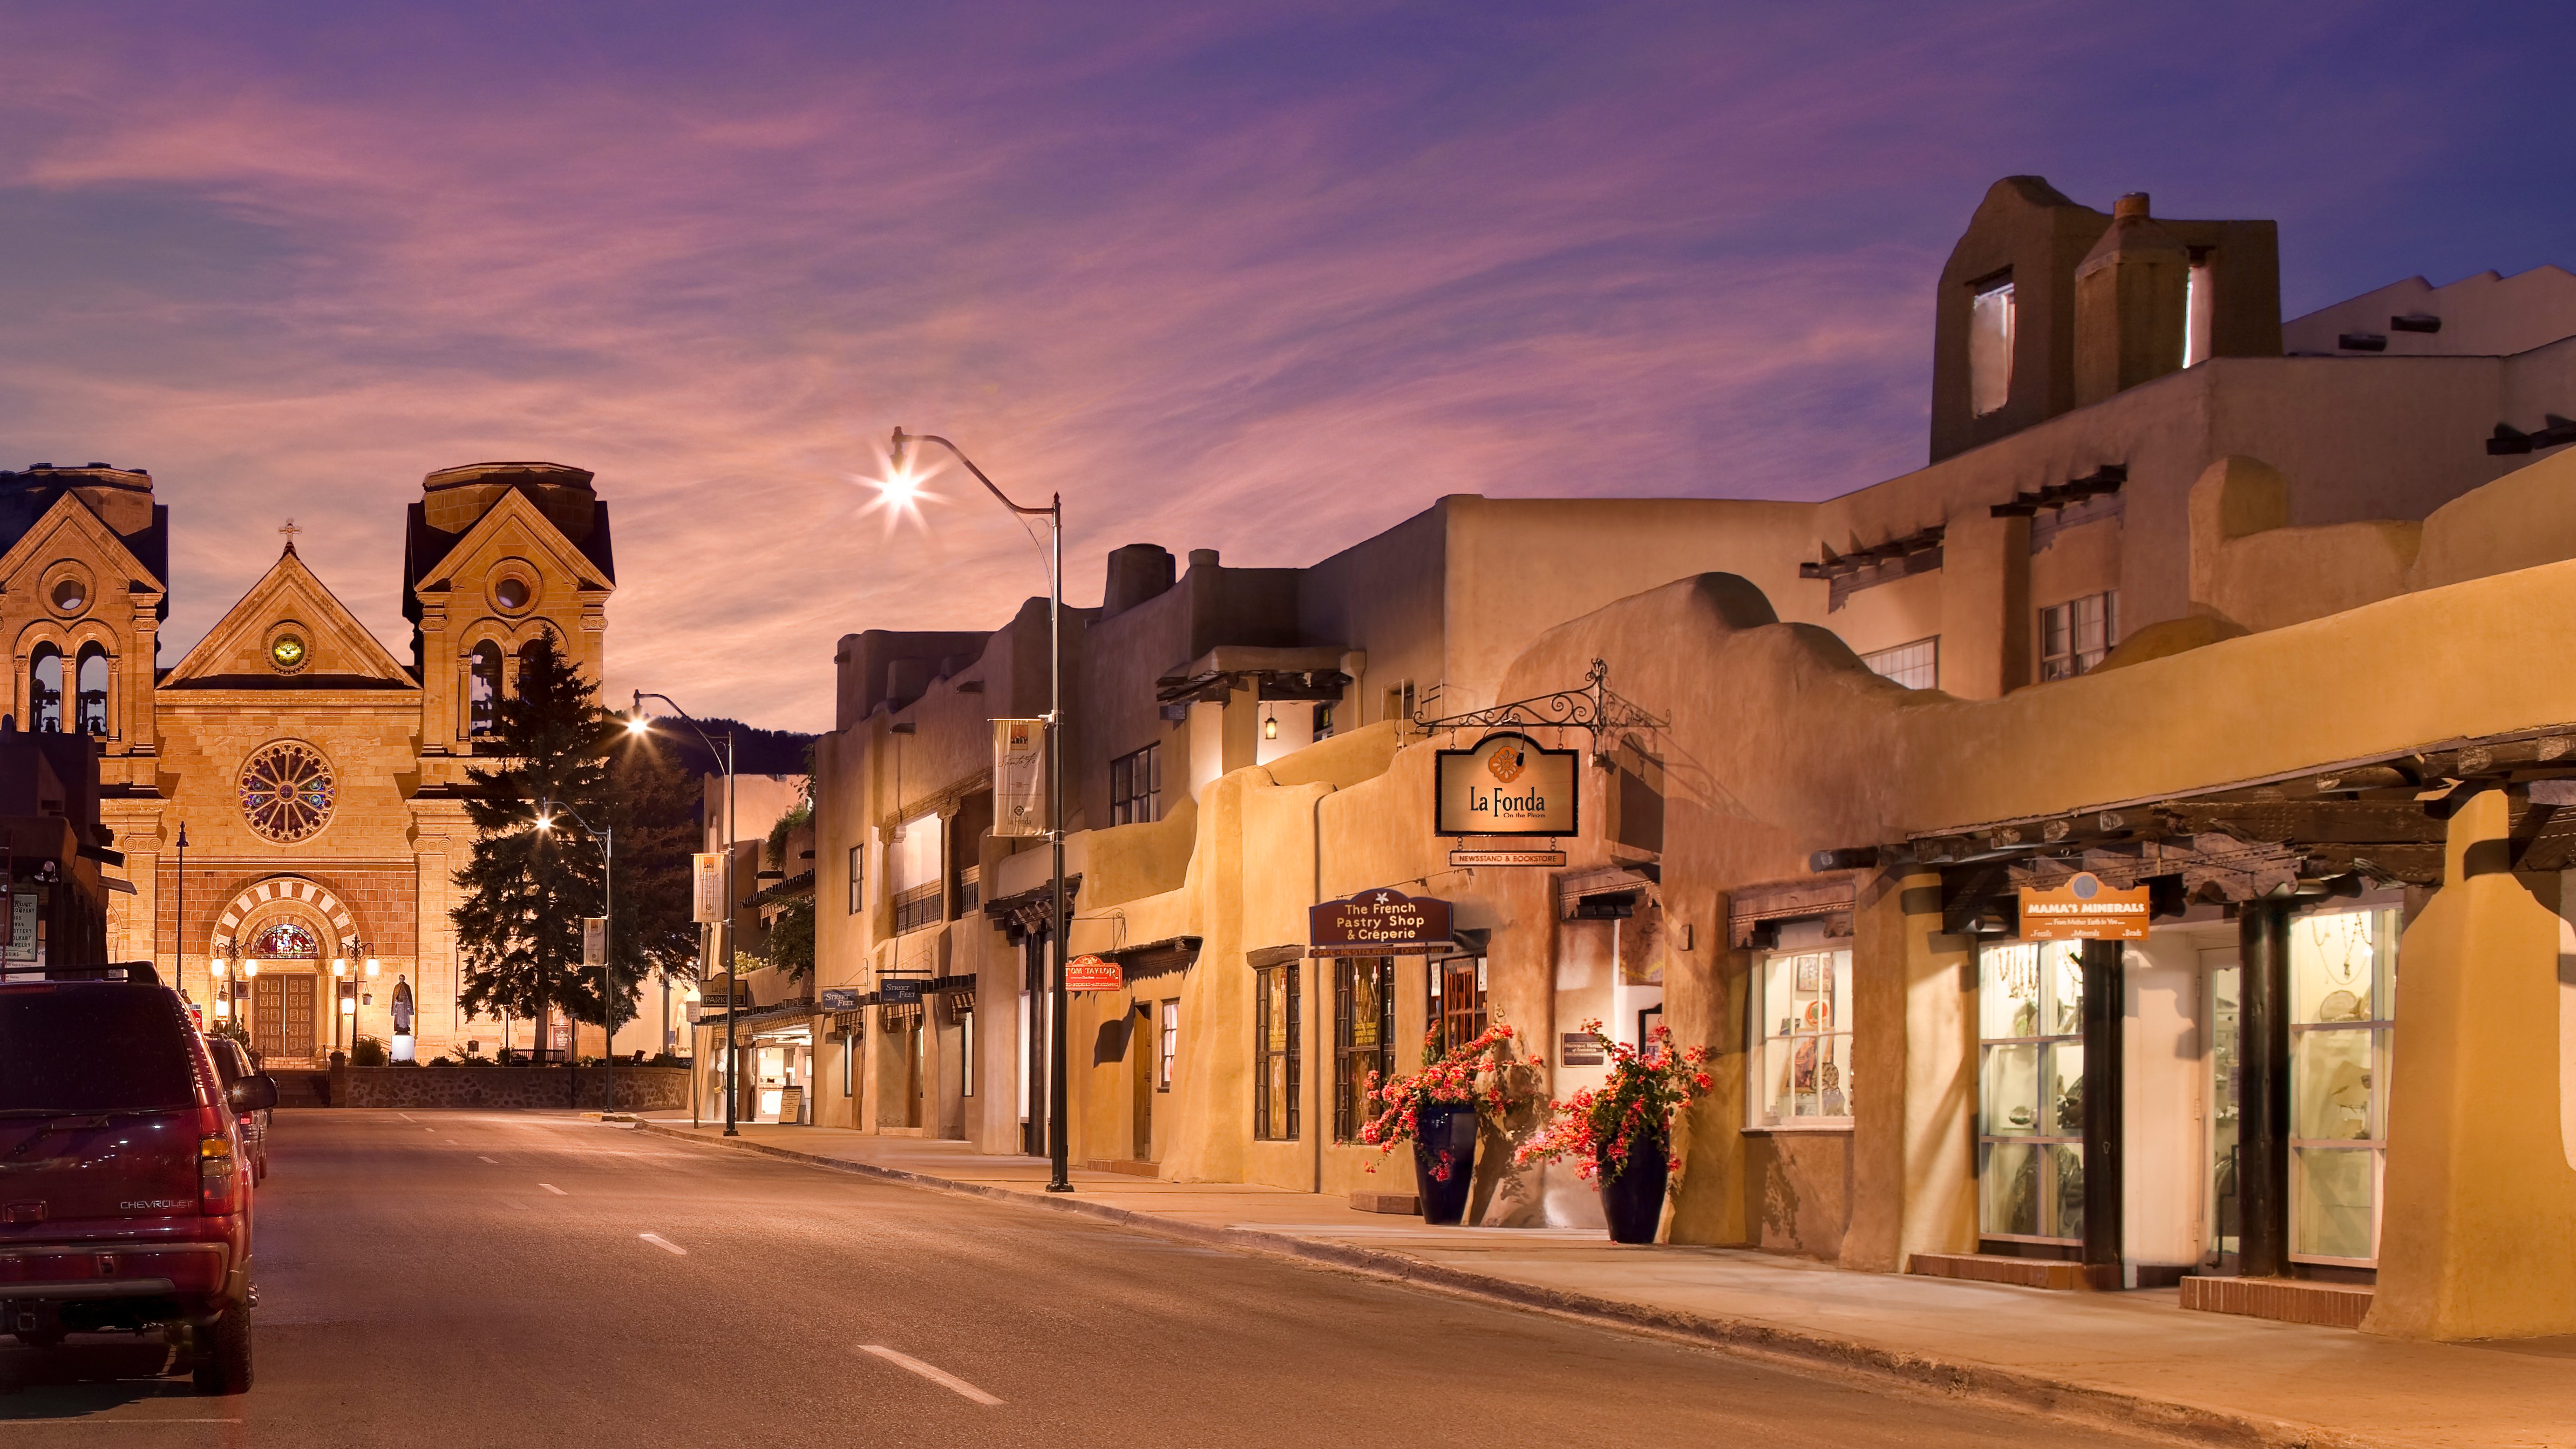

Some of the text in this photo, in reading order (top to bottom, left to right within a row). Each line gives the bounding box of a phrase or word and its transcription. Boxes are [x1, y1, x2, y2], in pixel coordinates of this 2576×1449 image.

[1470, 786, 1545, 817] La Fonda
[1007, 816, 1032, 827] La Fonda
[15, 900, 32, 908] River
[1345, 902, 1416, 915] The French
[2028, 903, 2145, 914] MAMA'S MINERALS
[1337, 915, 1425, 929] Pastry Shop
[1347, 930, 1355, 940] &
[2125, 929, 2142, 937] Beads
[1341, 948, 1398, 956] RESTAURANT
[1085, 967, 1119, 979] TAYLOR
[711, 984, 718, 992] La
[120, 1200, 193, 1209] CHEVROLET
